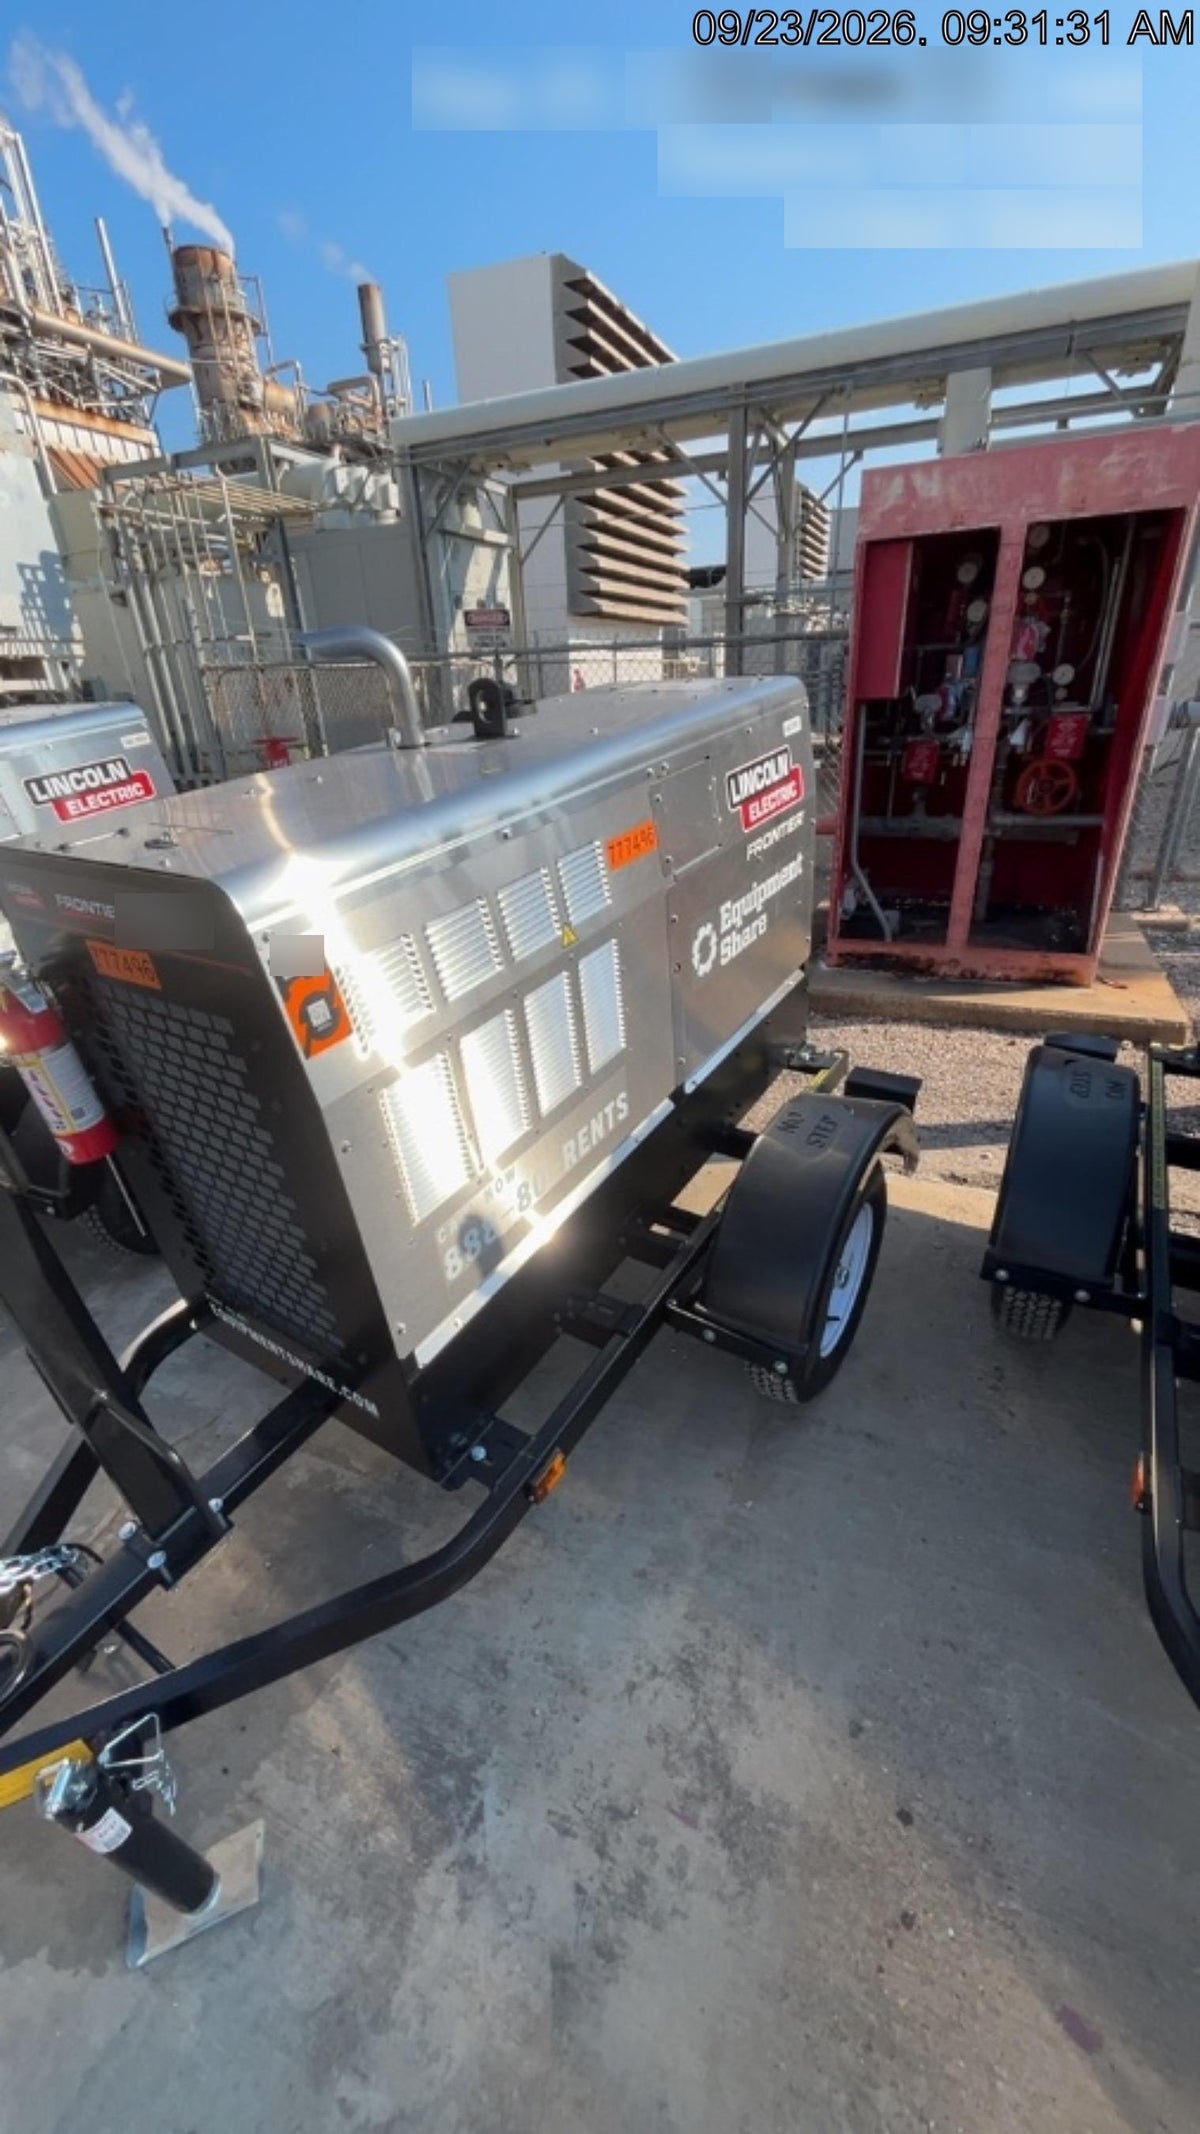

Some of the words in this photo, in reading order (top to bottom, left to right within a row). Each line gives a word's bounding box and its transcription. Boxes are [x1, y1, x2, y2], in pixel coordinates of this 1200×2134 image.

[29, 759, 127, 802] LINCOLN
[64, 781, 146, 815] ELECTRIC
[729, 753, 789, 804] LINCOLN
[748, 778, 799, 823] ELECTRIC
[746, 809, 806, 862] FRONTIER
[54, 892, 117, 919] FRONTIE
[719, 851, 803, 934] Equipment
[719, 911, 768, 967] Share
[562, 1091, 630, 1170] RENTS
